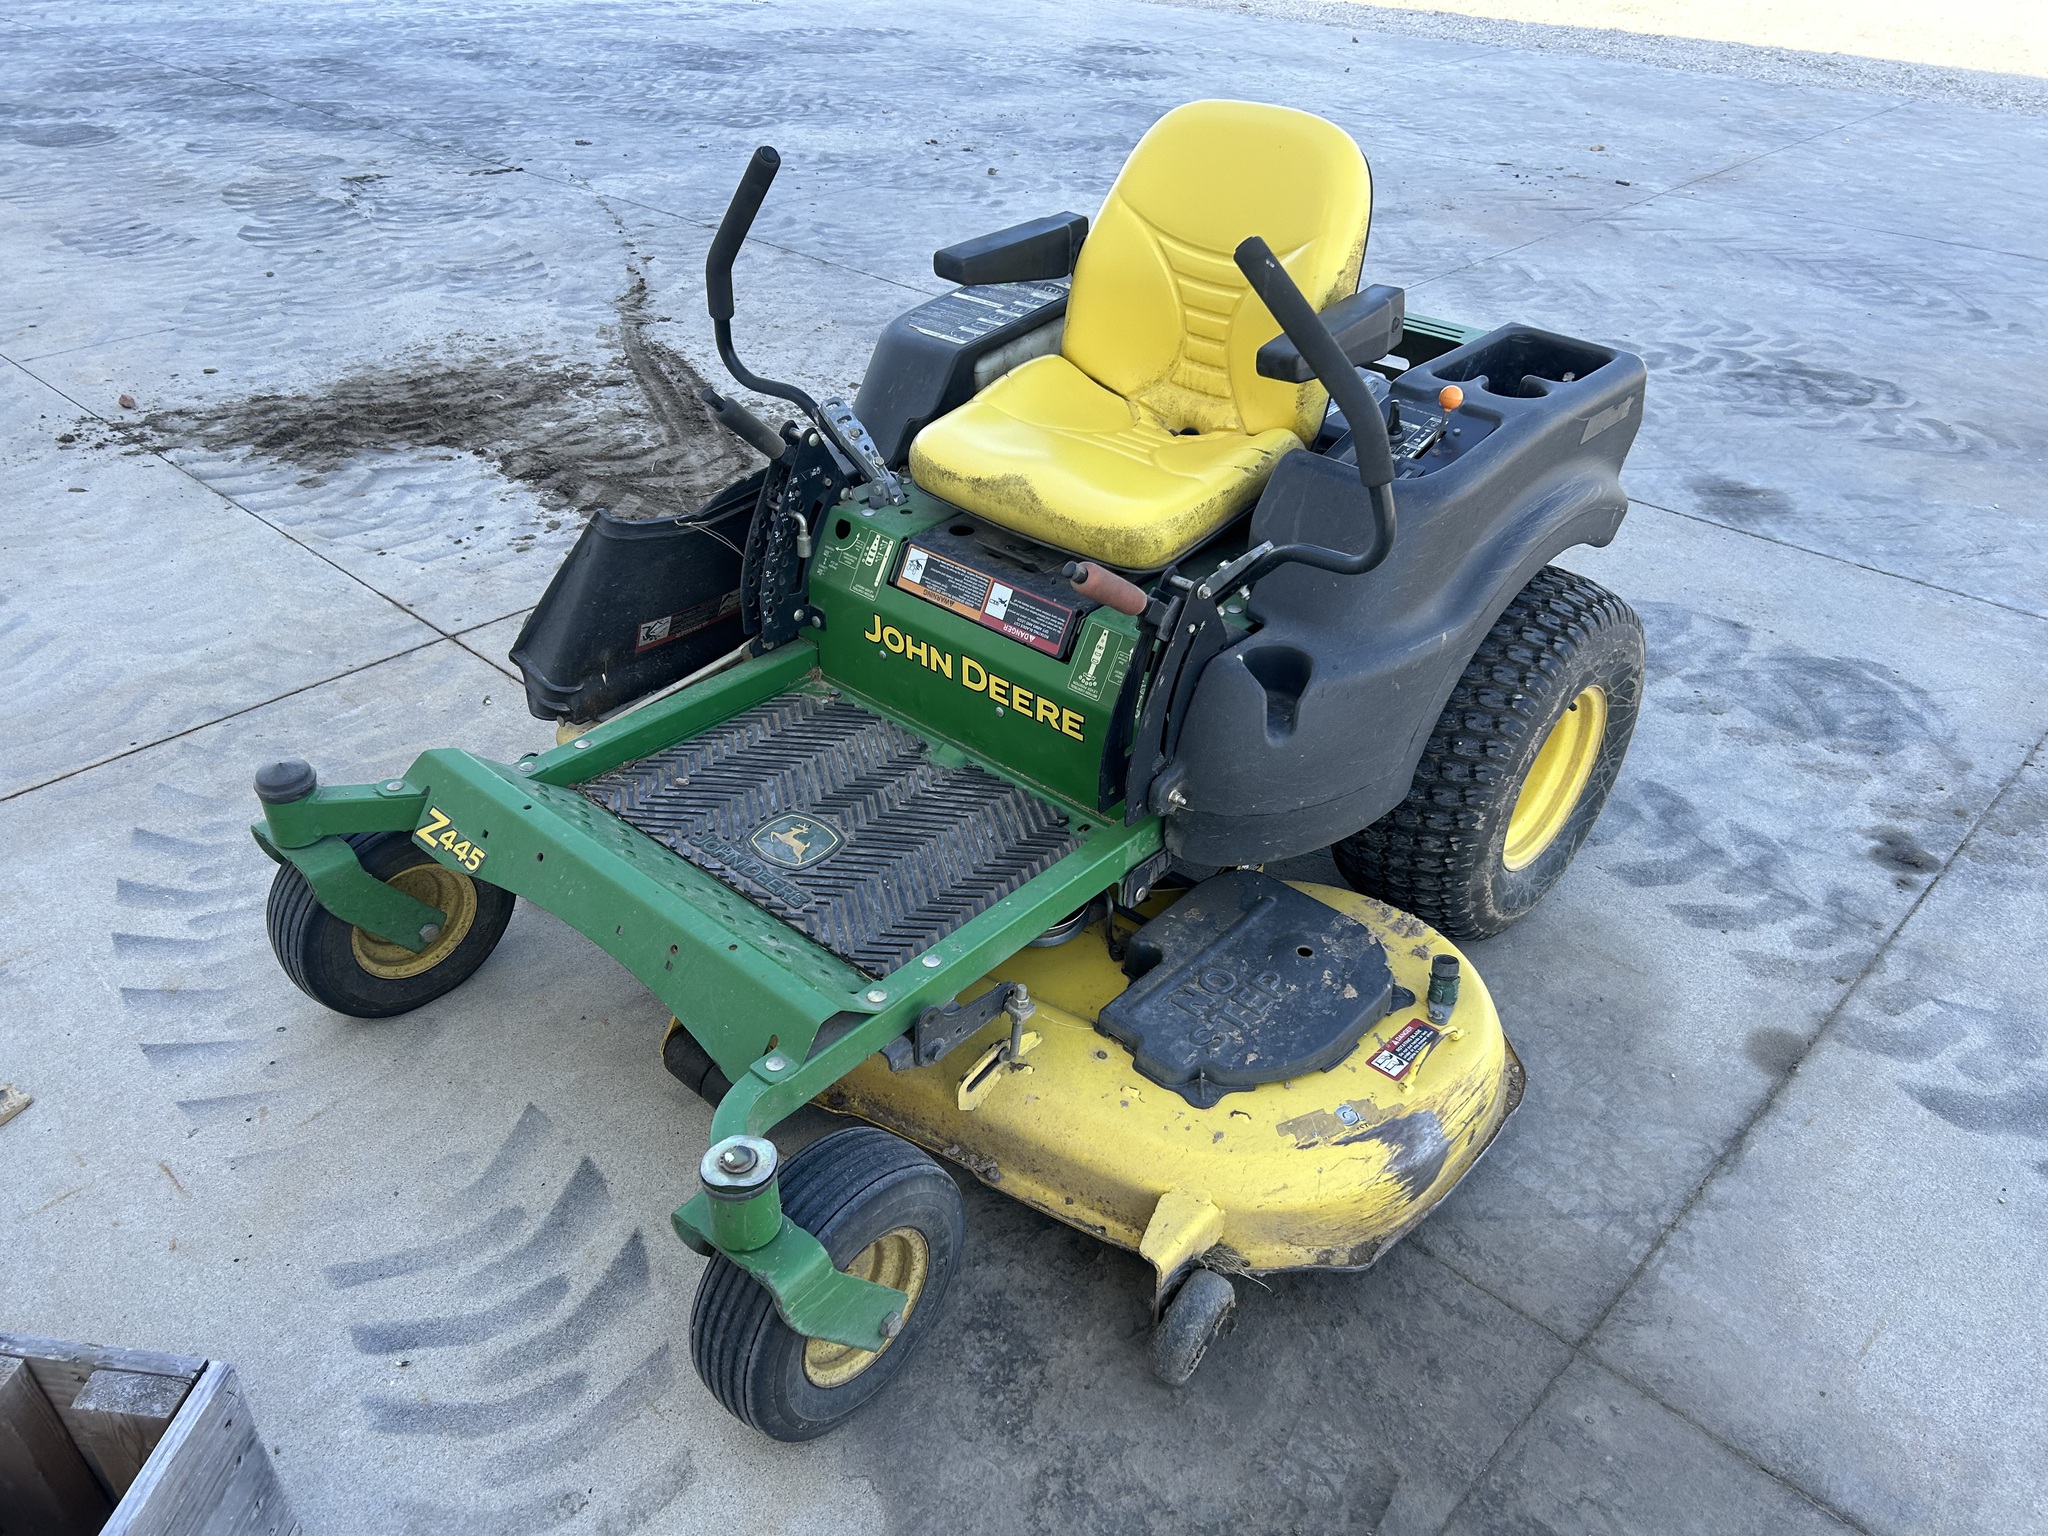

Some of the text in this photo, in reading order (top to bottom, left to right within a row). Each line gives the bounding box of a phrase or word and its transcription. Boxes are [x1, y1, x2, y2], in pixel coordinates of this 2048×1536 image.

[923, 589, 949, 605] WARNING
[1003, 623, 1029, 640] DANGER
[864, 613, 953, 680] JOHN
[961, 655, 1085, 742] DEERE
[415, 807, 487, 872] Z445
[690, 833, 810, 908] JOHN DEERE
[1170, 967, 1237, 1020] NO
[1189, 970, 1281, 1054] STEP
[1394, 1026, 1414, 1041] DANGER
